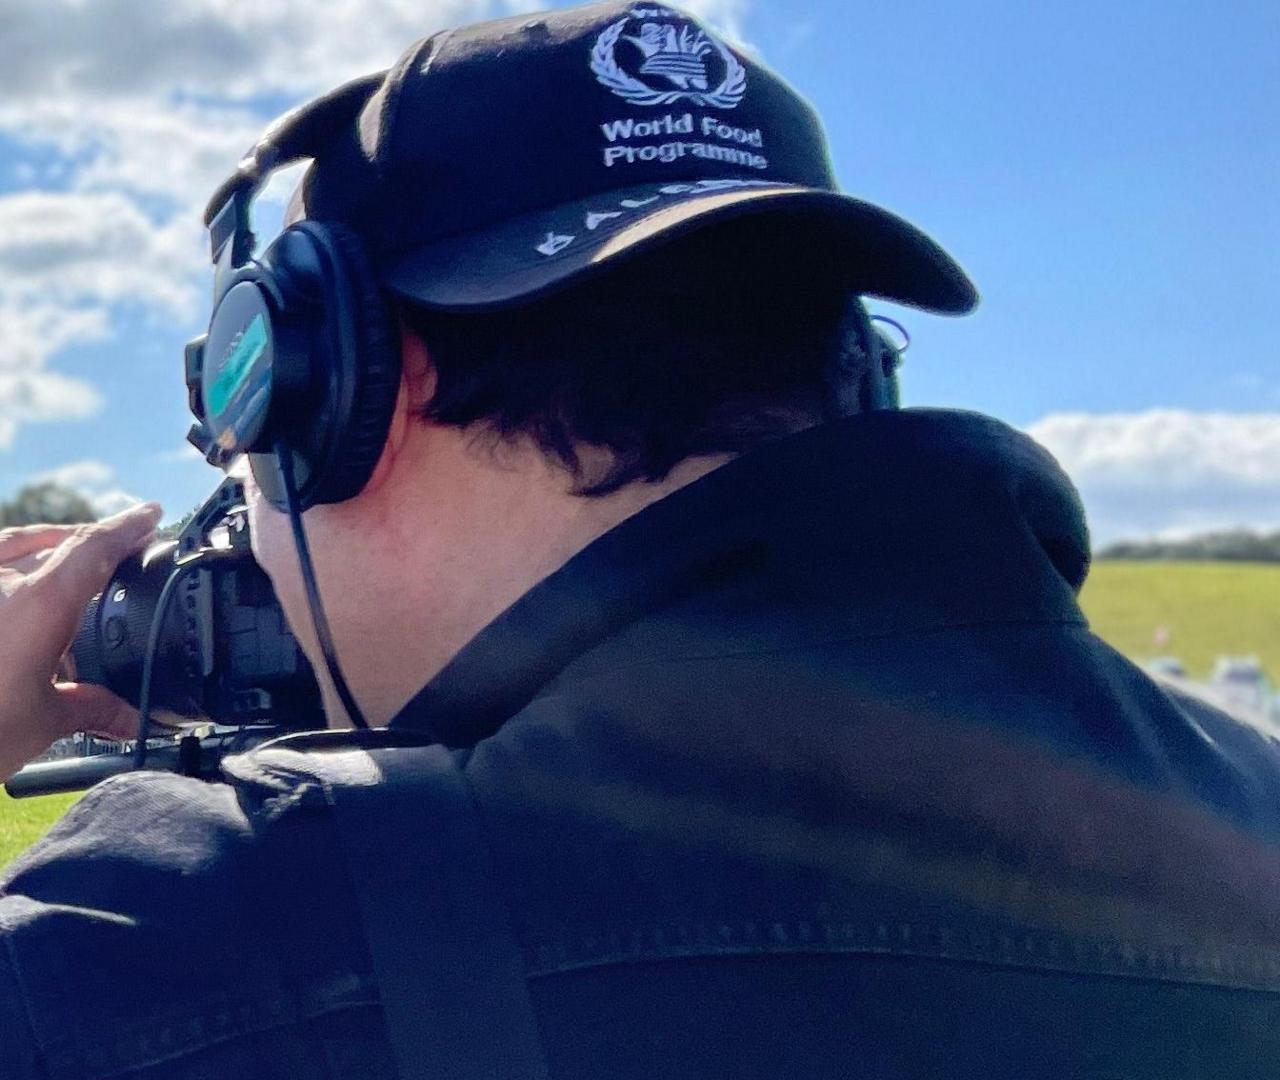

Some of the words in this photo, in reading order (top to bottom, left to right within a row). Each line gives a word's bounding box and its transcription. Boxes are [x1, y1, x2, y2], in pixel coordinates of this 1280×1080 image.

[600, 112, 694, 142] World
[701, 116, 763, 148] Food
[603, 141, 769, 169] Programme
